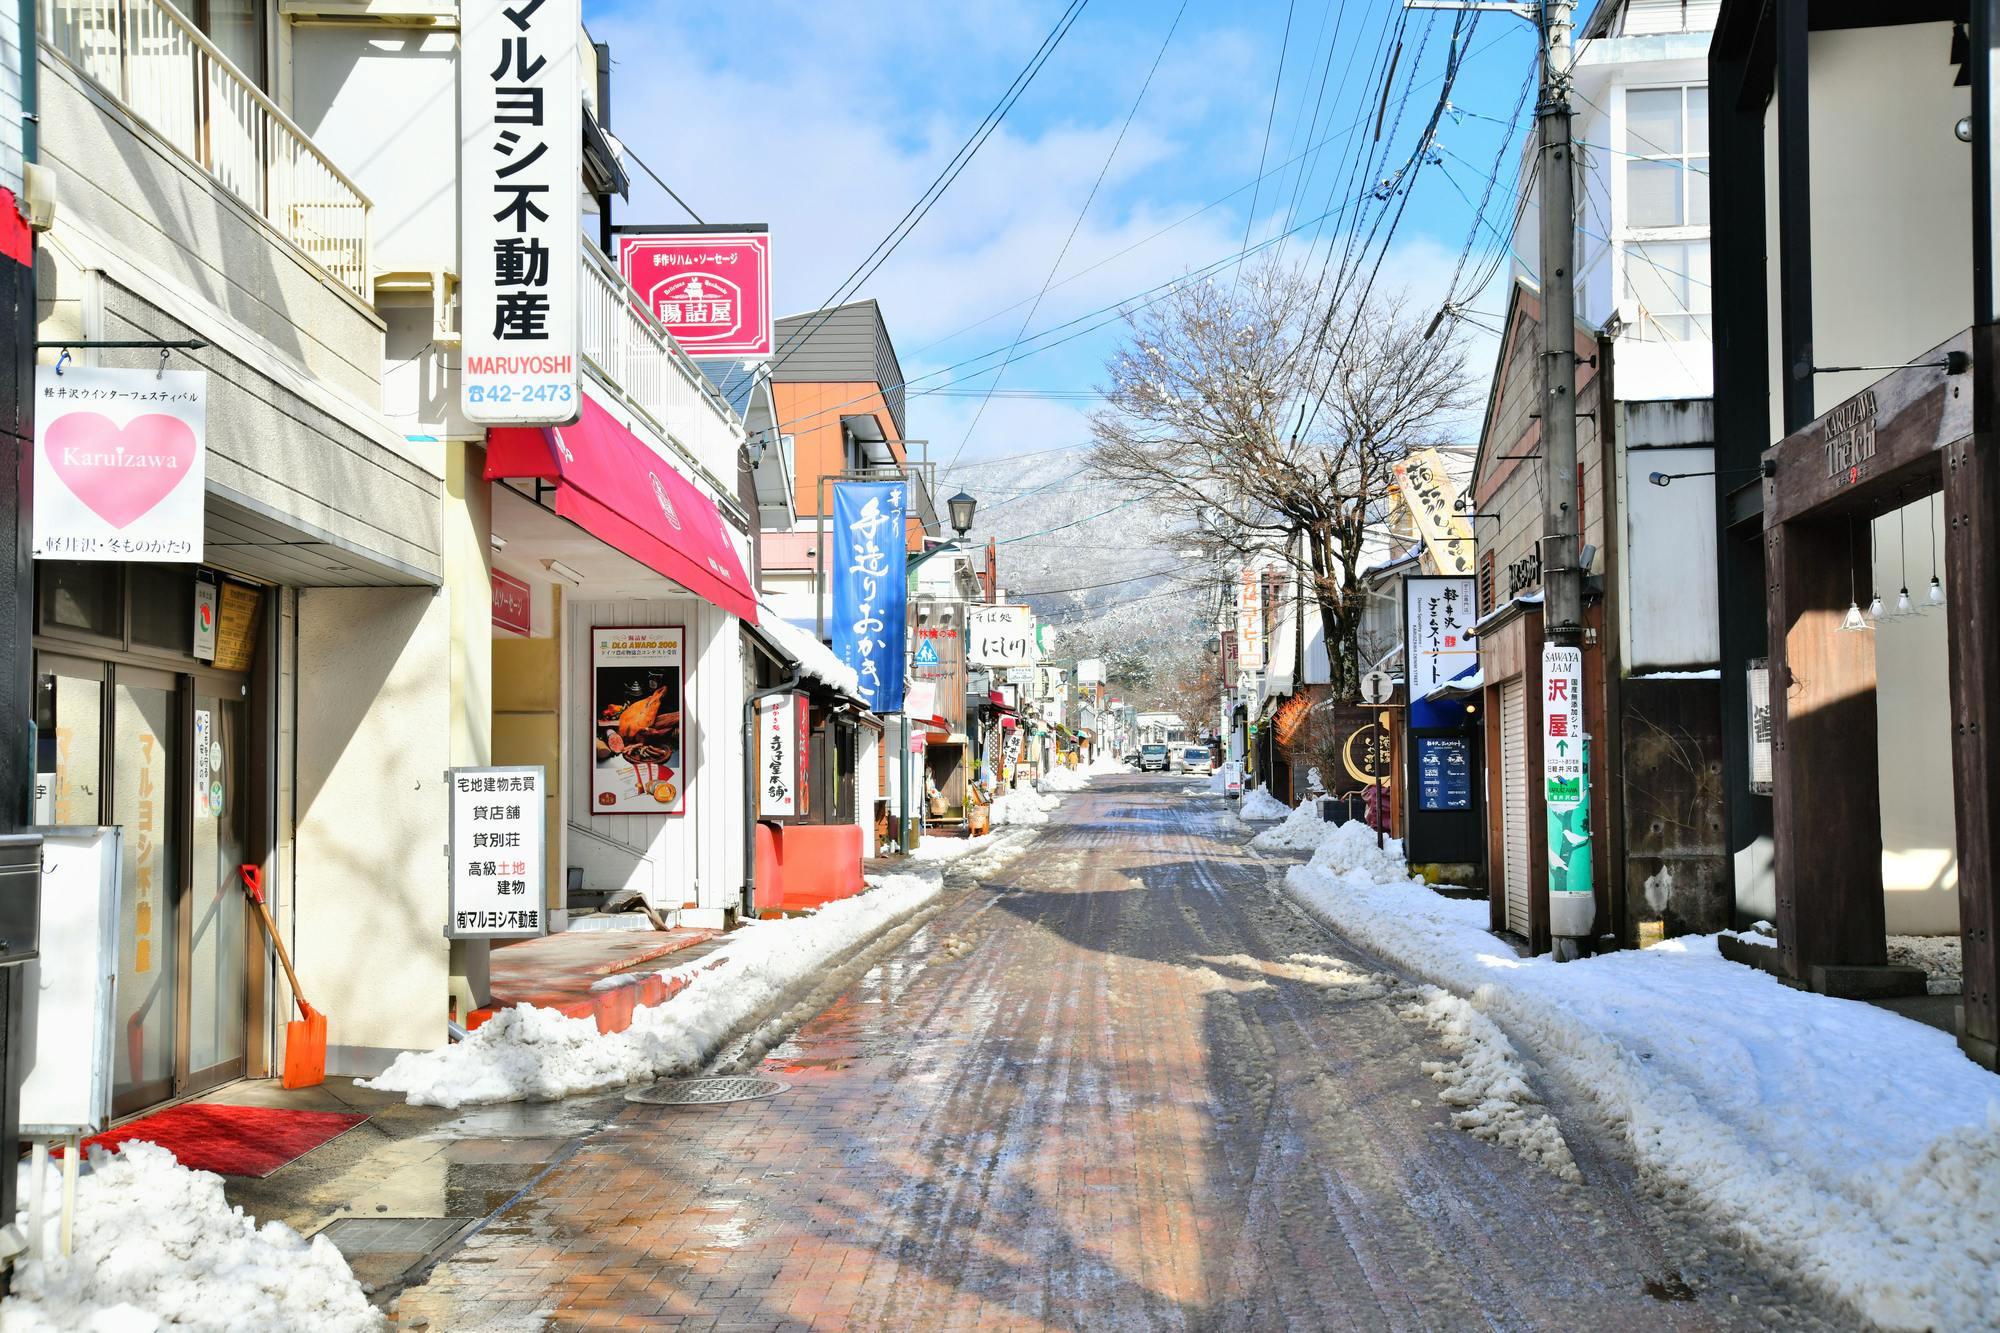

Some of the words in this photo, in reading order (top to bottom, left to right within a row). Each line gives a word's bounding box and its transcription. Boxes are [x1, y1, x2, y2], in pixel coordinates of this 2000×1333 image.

[490, 0, 550, 341] マルヨシ不動産
[652, 252, 739, 266] 手作りハム・ソーセージ
[659, 302, 732, 324] 腸詰屋
[468, 355, 571, 375] MARUYOSHI
[44, 386, 199, 403] 軽井沢ウインターフェスティバル
[1824, 390, 1878, 441] KARUIZAWA
[63, 446, 178, 469] Karuizawa
[1825, 439, 1852, 479] The
[45, 536, 192, 554] 軽井沢・冬ものがたり
[849, 496, 891, 696] 手造りおかき
[975, 612, 1013, 623] そば処
[1443, 586, 1462, 630] 軽井沢
[612, 641, 628, 649] DLG
[629, 641, 657, 649] AWARD
[982, 636, 1026, 659] にし川
[1427, 597, 1441, 685] デニムストリート
[1545, 652, 1579, 663] SAWAYA
[1551, 663, 1572, 673] JAM
[1548, 678, 1568, 738] 沢屋
[1570, 678, 1578, 738] 国産無添加ジャム
[768, 734, 788, 803] 寺子屋本舗
[457, 776, 535, 793] 宅地建物売買
[473, 805, 521, 820] 貸店舗
[473, 832, 521, 848] 貸別荘
[468, 860, 526, 877] 高級土地
[497, 880, 526, 895] 建物
